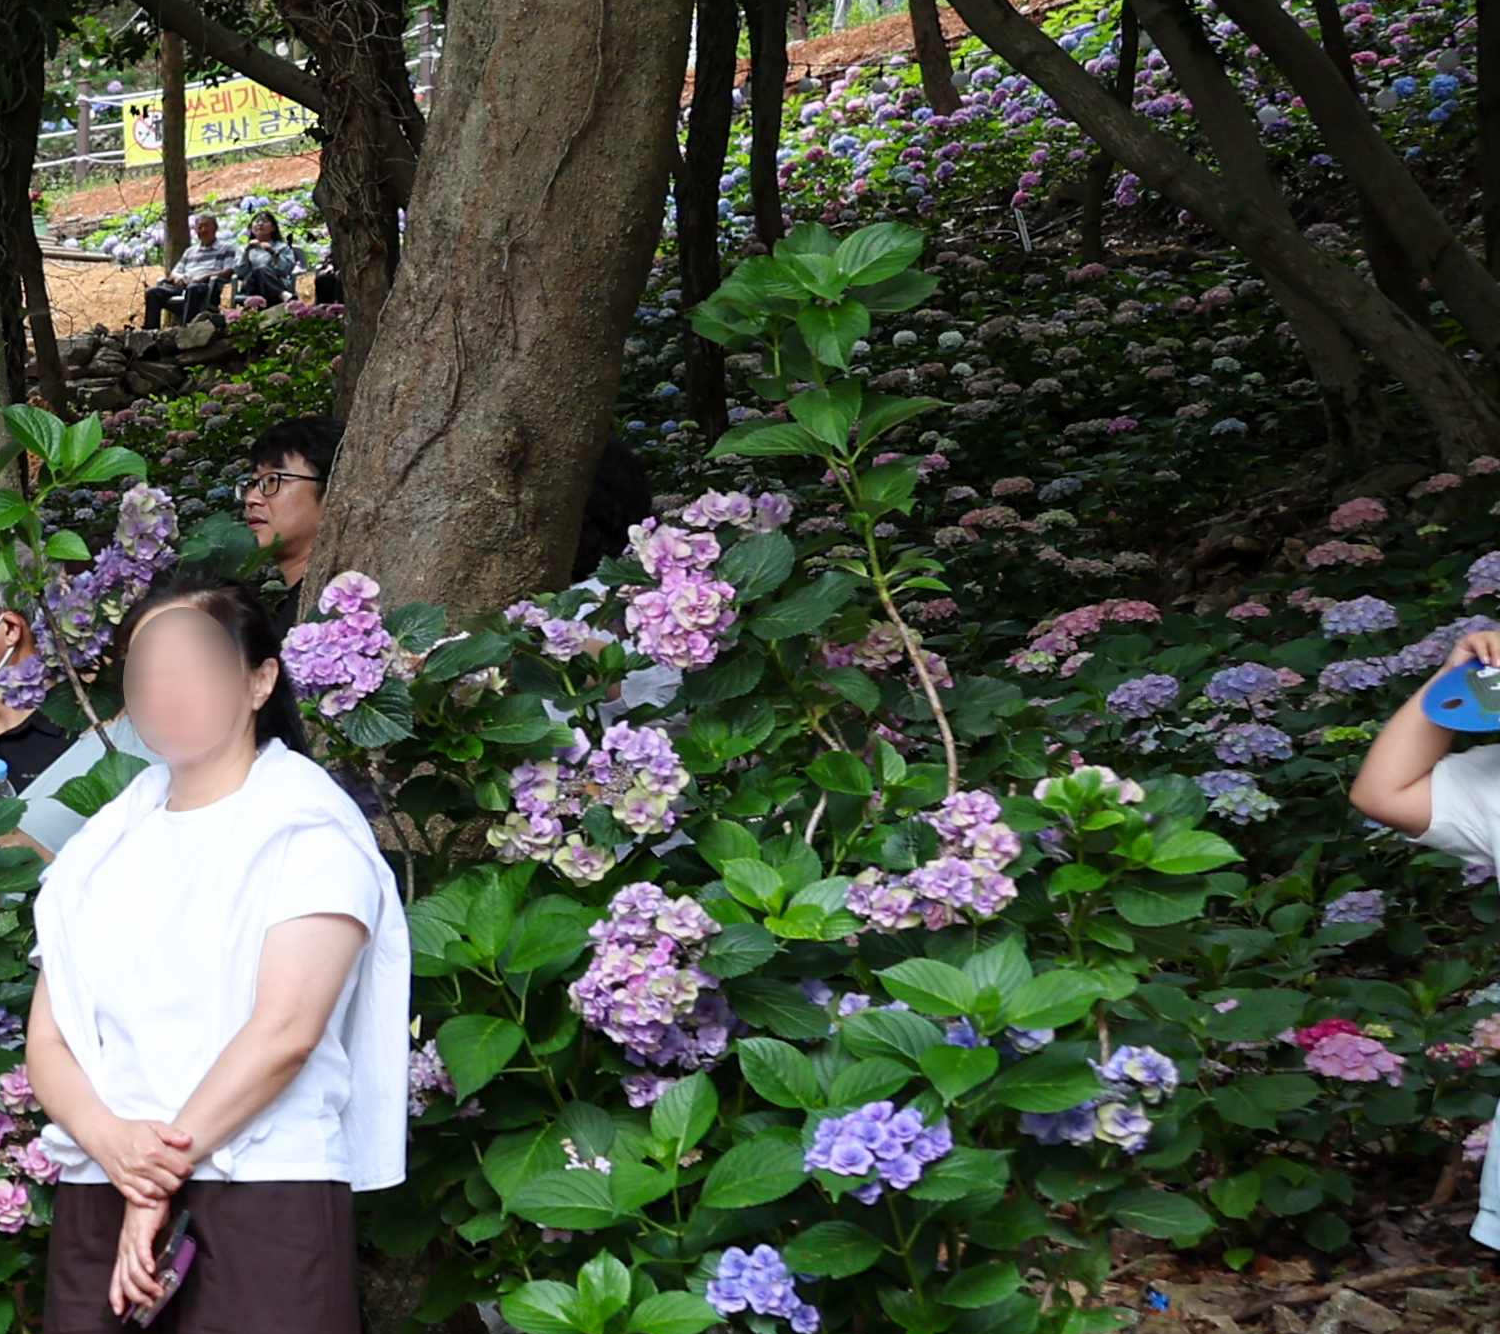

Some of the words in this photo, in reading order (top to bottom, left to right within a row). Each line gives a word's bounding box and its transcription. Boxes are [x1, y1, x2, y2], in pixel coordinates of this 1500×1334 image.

[185, 85, 259, 119] 쓰레기
[201, 116, 250, 145] 취사
[259, 104, 307, 135] 금지
